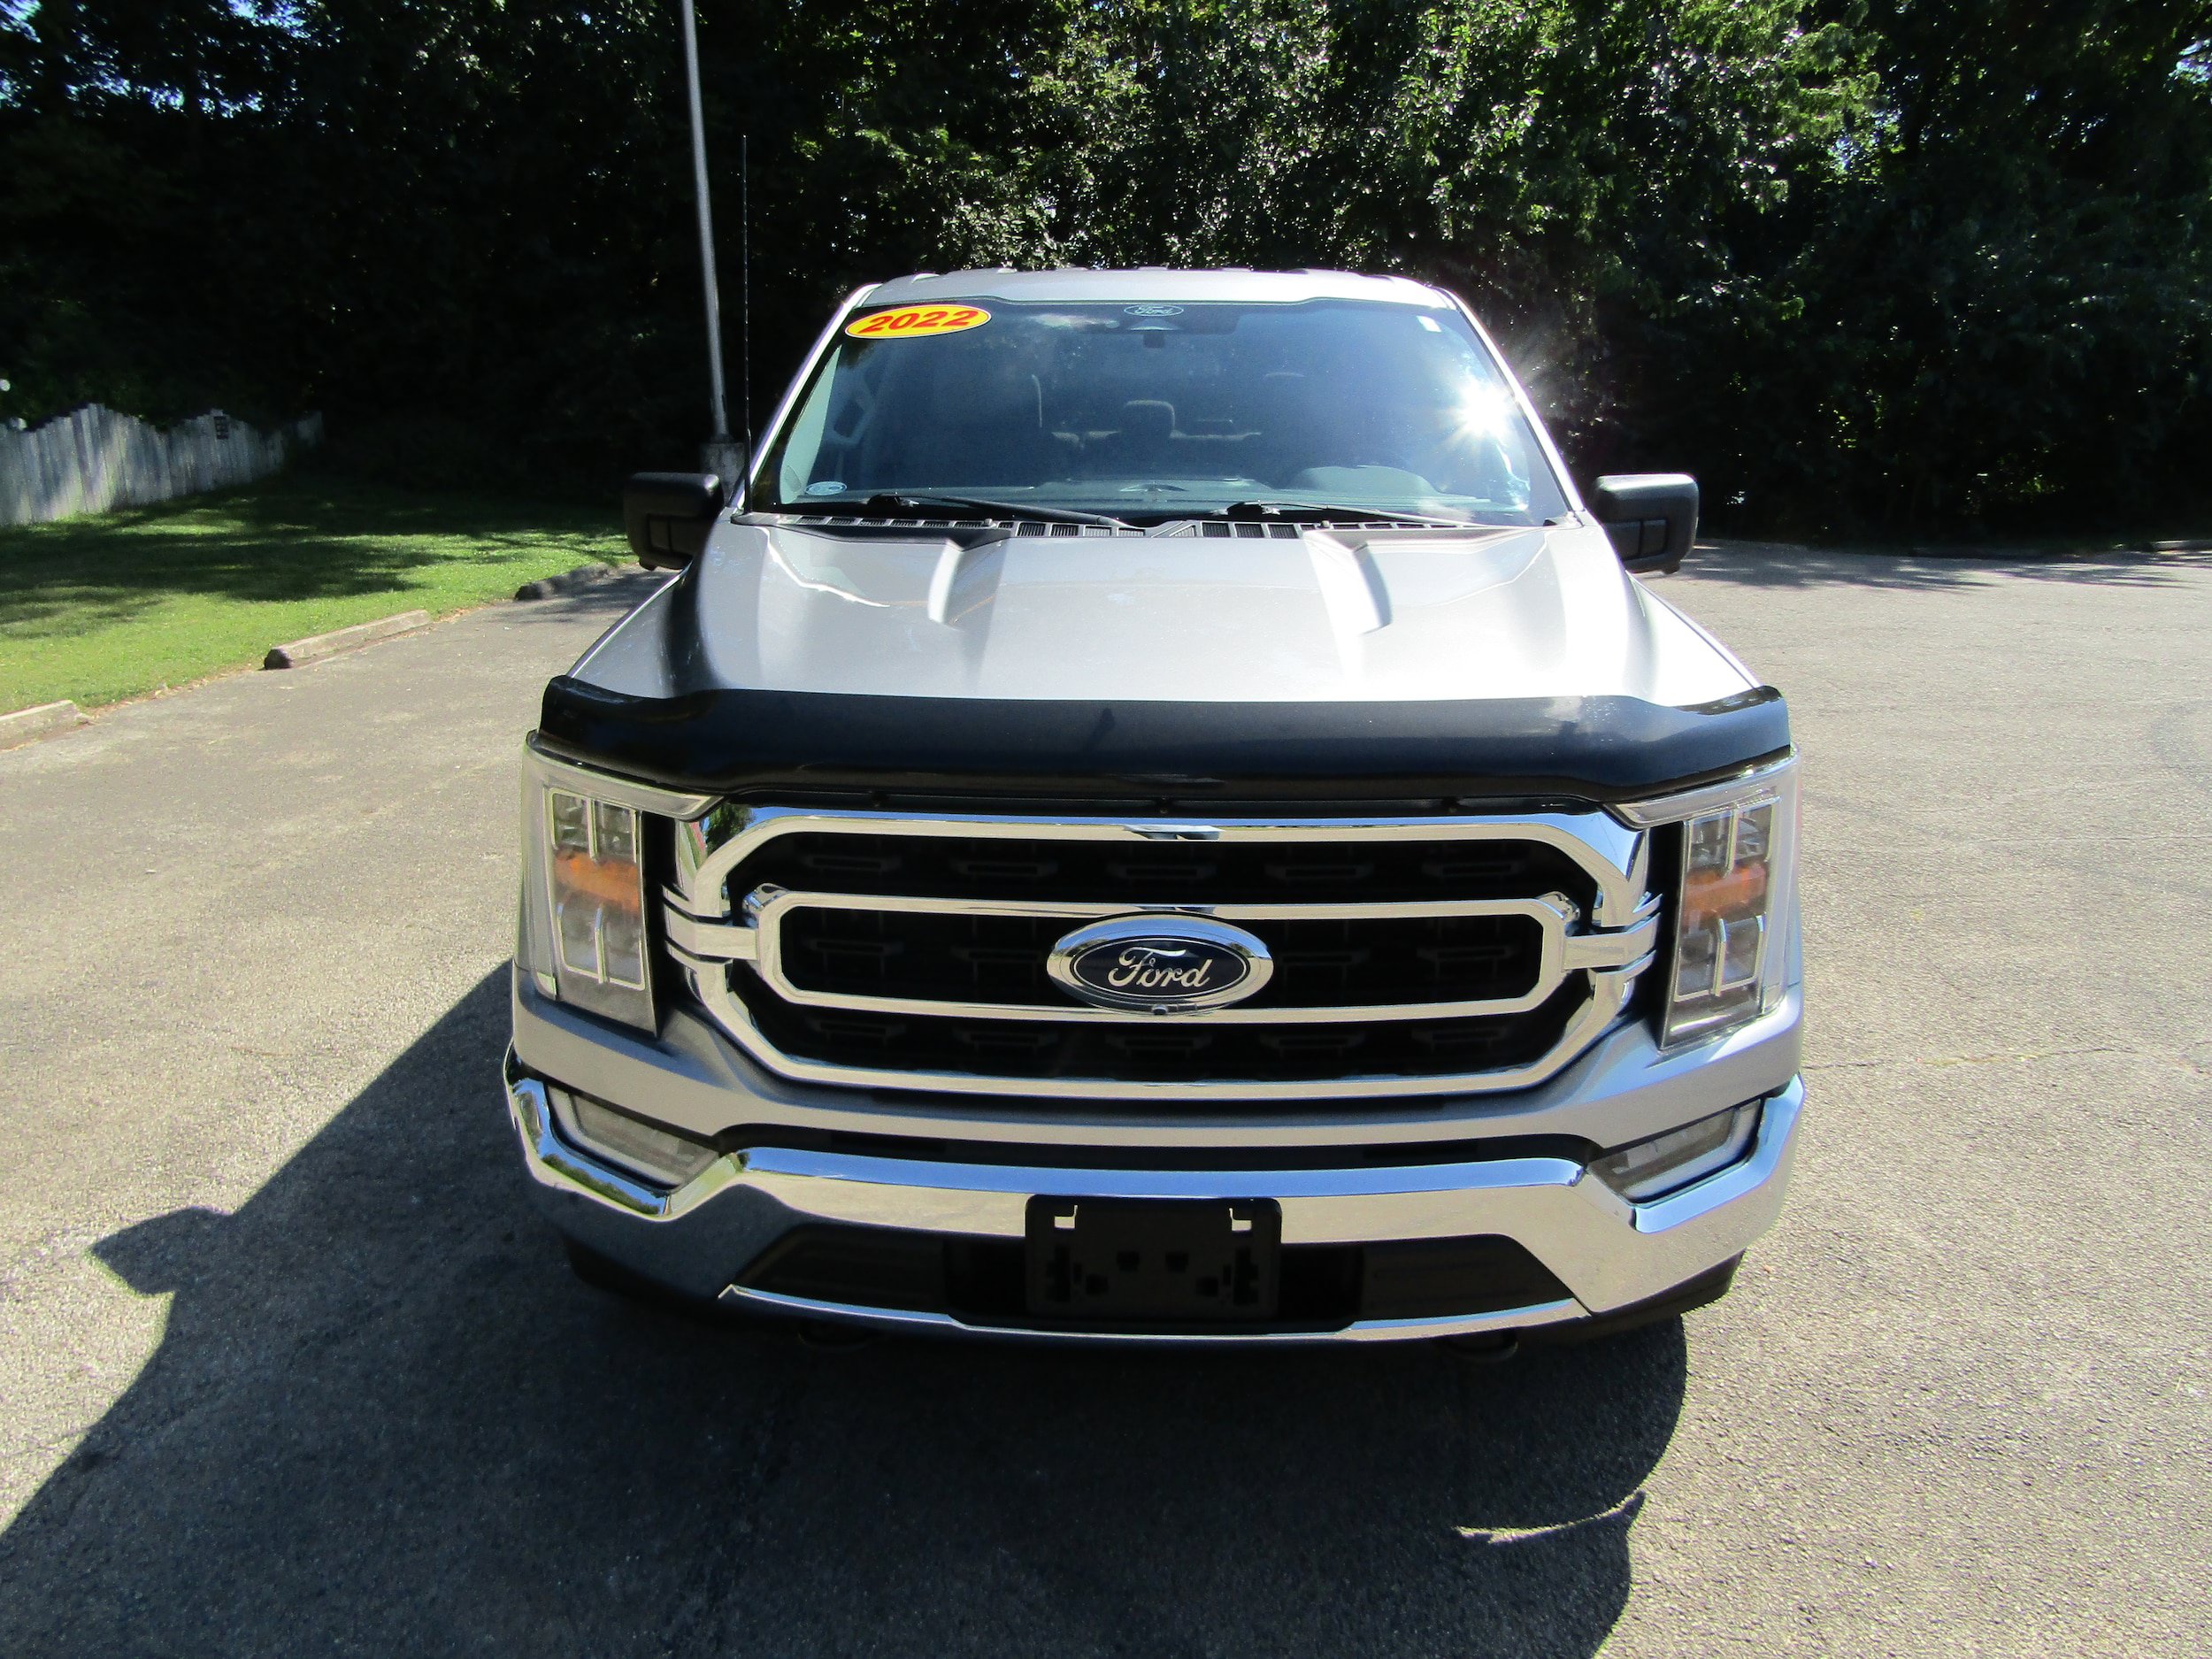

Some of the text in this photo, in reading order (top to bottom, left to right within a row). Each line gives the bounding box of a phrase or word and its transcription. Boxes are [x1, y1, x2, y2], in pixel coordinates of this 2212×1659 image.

[1134, 304, 1173, 314] Ford
[857, 311, 979, 334] 2022
[1107, 947, 1213, 987] Ford
